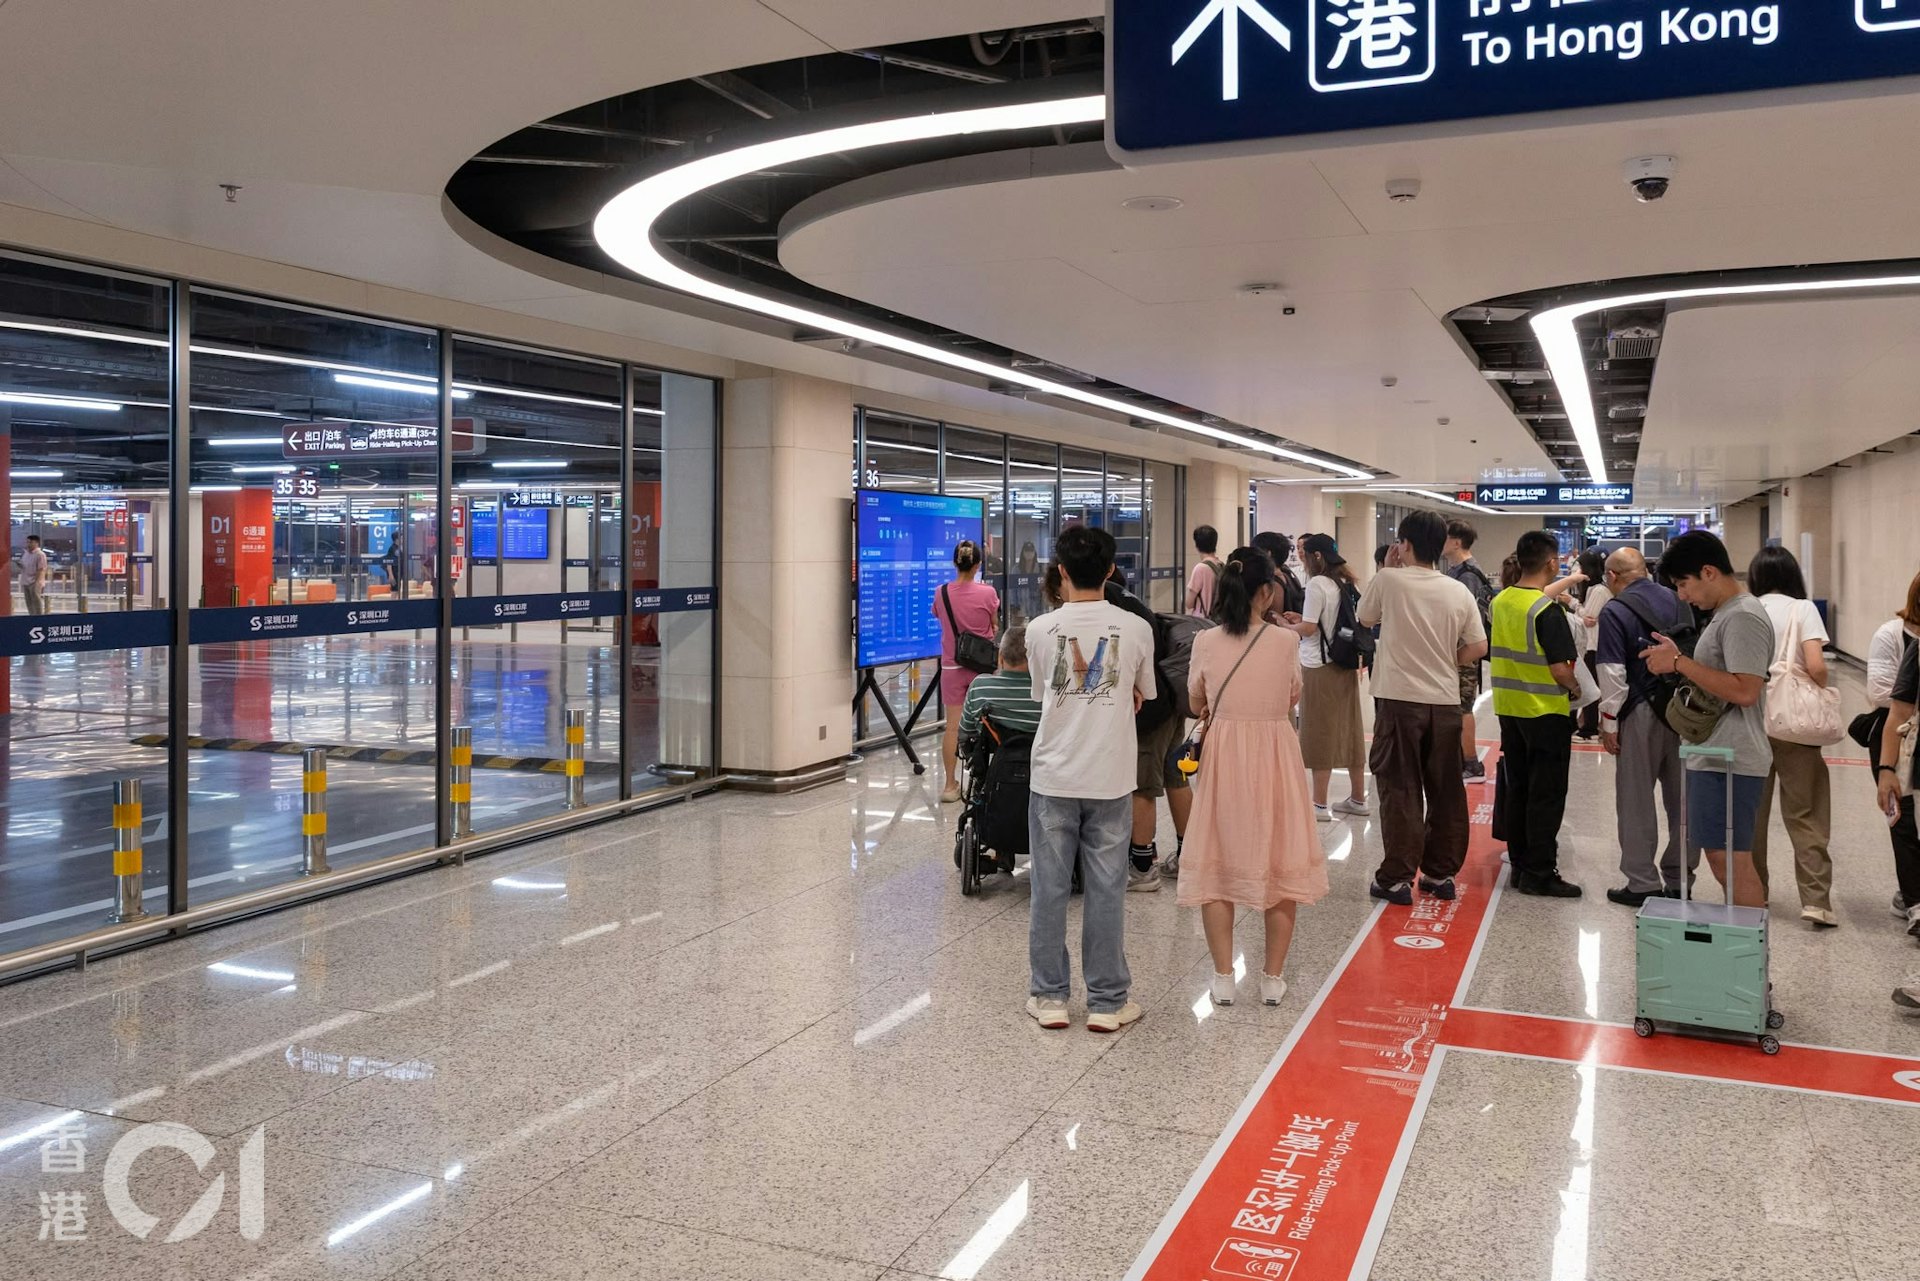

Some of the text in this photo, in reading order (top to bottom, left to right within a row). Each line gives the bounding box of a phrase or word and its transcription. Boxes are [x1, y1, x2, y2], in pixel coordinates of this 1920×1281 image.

[1325, 0, 1418, 69] 港
[1462, 3, 1779, 66] To Hong Kong
[866, 469, 879, 487] 36
[276, 479, 293, 494] 35
[299, 479, 316, 495] 35
[1459, 492, 1472, 502] 09
[211, 516, 230, 534] D1
[373, 526, 387, 537] C1
[264, 614, 298, 625] 深圳口岸
[359, 609, 389, 619] 深圳口岸
[48, 624, 93, 636] 深圳口岸
[1288, 1121, 1360, 1240] Ride-Hailing Pick-Up Point
